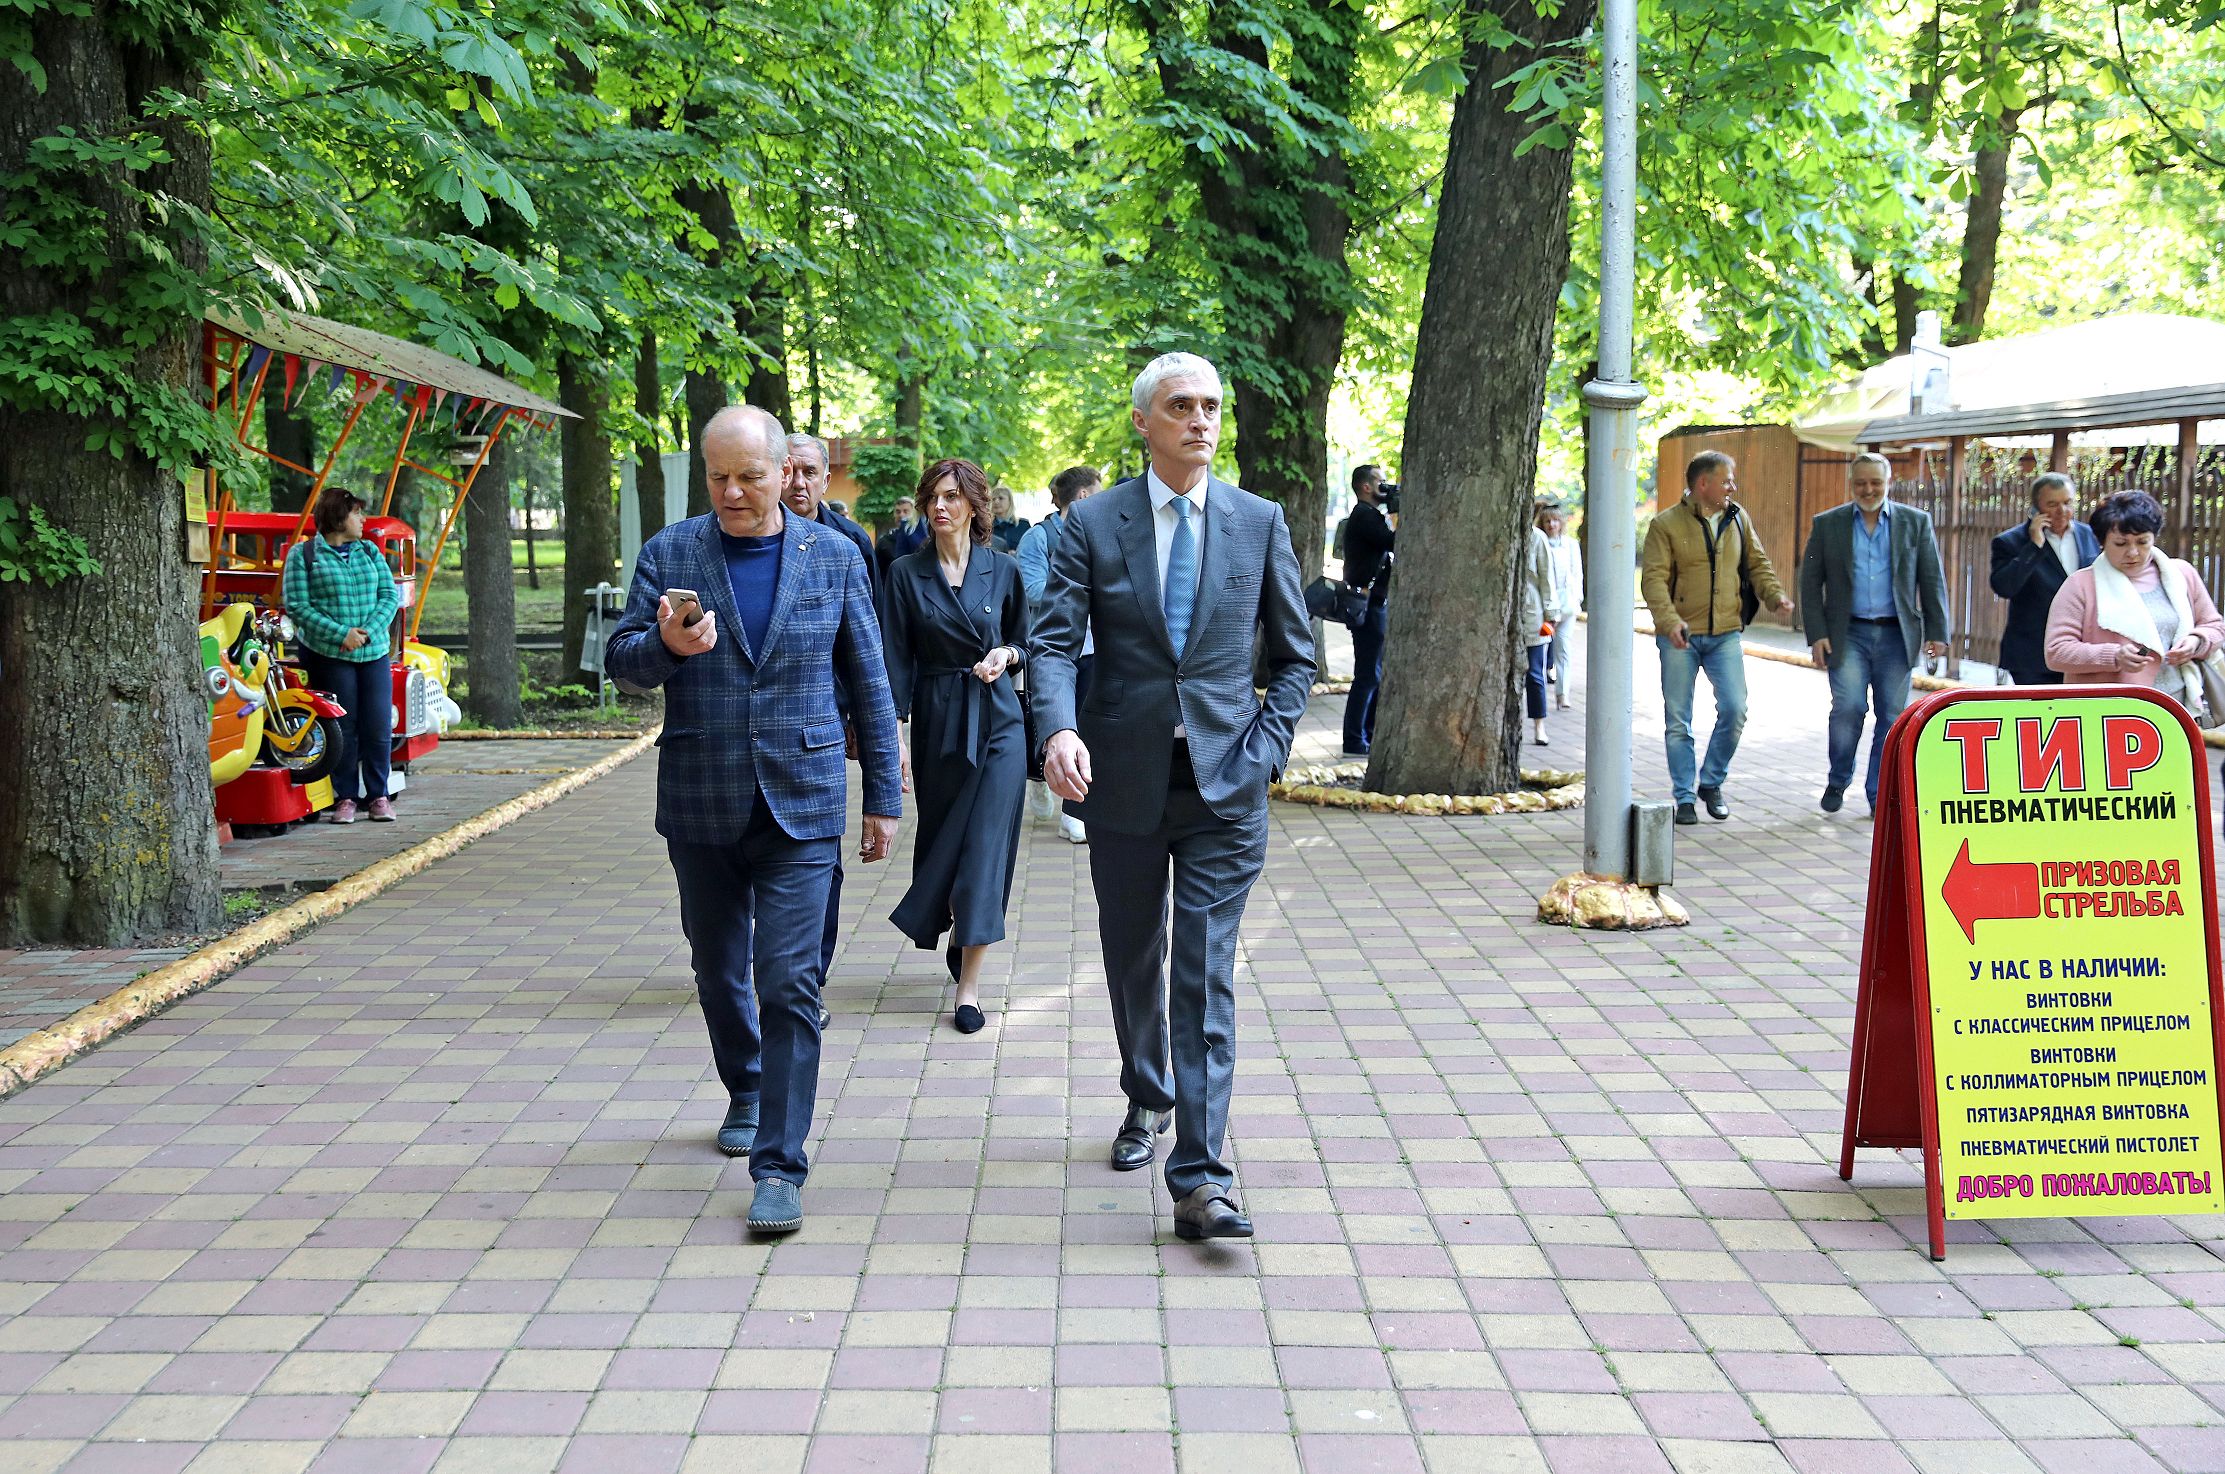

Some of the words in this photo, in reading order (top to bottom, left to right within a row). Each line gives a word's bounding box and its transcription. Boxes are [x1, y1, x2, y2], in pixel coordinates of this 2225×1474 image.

[1943, 715, 2163, 794] ТИР
[1940, 792, 2176, 824] ПНЕВМАТИЧЕСКИЙ
[2041, 859, 2181, 887] ПРИЗОВАЯ
[2043, 890, 2184, 918] СТРЕЛЬБА
[1969, 960, 1982, 980] У
[1991, 960, 2030, 980] НАС
[2039, 959, 2052, 979] В
[2061, 958, 2166, 979] НАЛИЧИИ:
[2026, 992, 2112, 1009] ВИНТОВКИ
[1954, 1019, 1963, 1035] С
[1969, 1016, 2094, 1035] КЛАССИЧЕСКИМ
[2100, 1015, 2190, 1034] ПРИЦЕЛОМ
[2030, 1047, 2116, 1064] ВИНТОВКИ
[1945, 1074, 1954, 1091] С
[1961, 1072, 2110, 1090] КОЛЛИМАТОРНЫМ
[2117, 1070, 2207, 1089] ПРИЦЕЛОМ
[1966, 1105, 2096, 1124] ПЯТИЗАРЯДНАЯ
[2102, 1103, 2189, 1120] ВИНТОВКА
[1960, 1135, 2110, 1156] ПНЕВМАТИЧЕСКИЙ
[2116, 1136, 2200, 1153] ПИСТОЛЕТ
[1956, 1174, 2034, 1202] ДОБРО
[2042, 1171, 2212, 1197] ПОЖАЛОВАТЬ!
